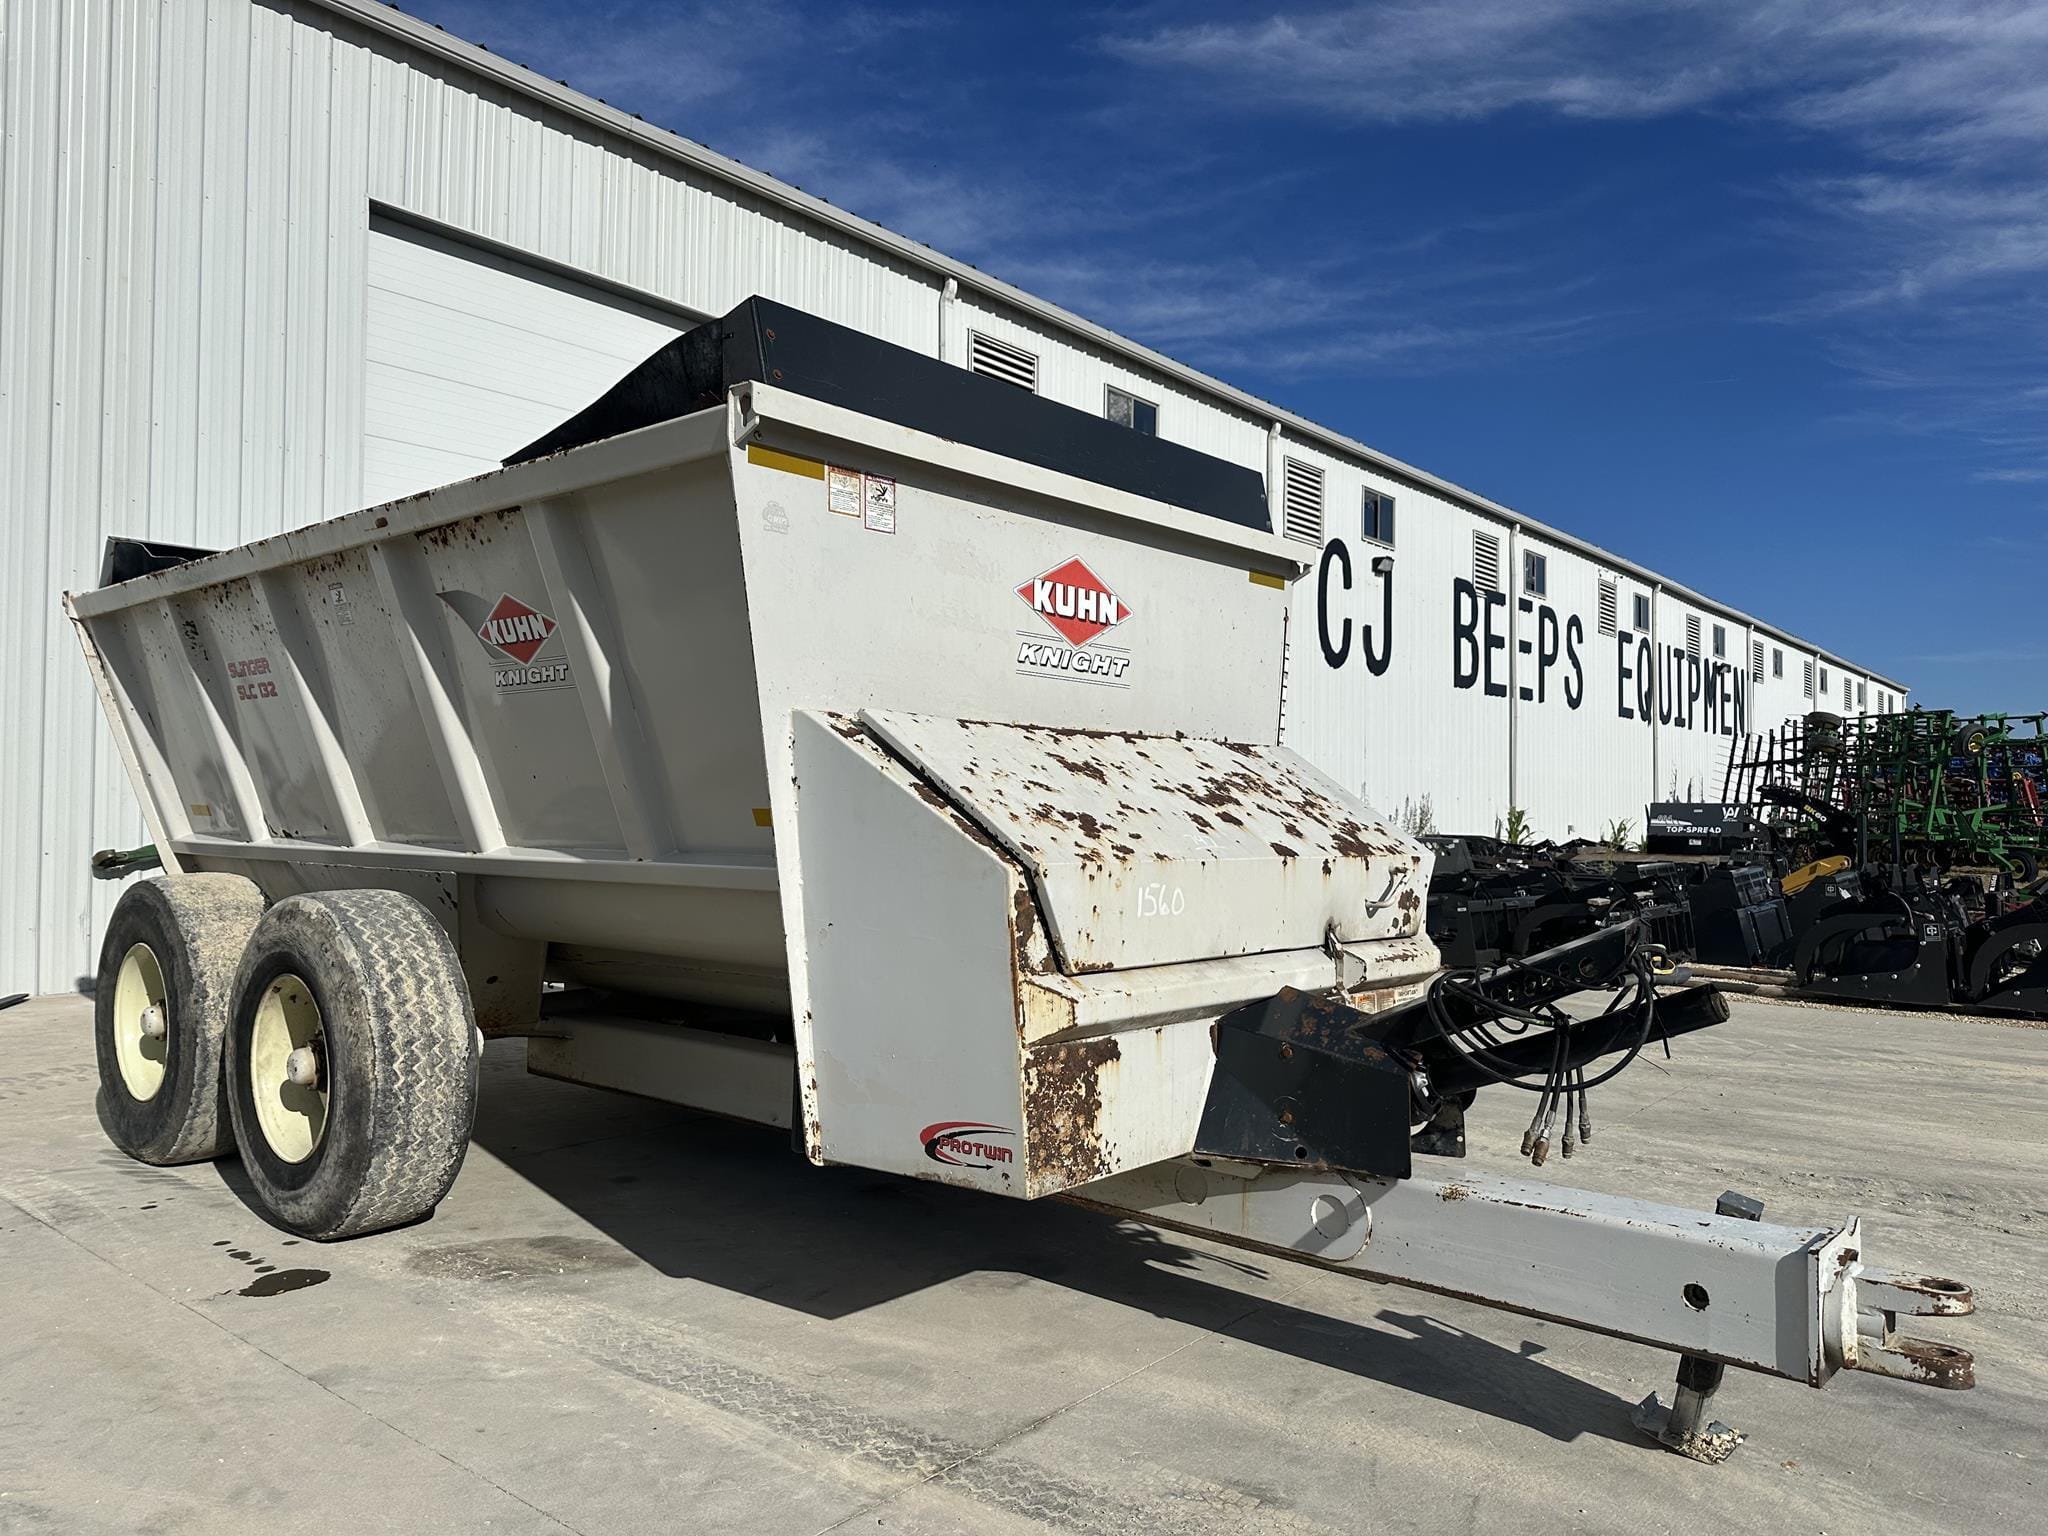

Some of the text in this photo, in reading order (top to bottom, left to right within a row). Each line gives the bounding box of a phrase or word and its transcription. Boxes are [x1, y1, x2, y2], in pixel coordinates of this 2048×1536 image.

[1033, 577, 1118, 626] KUHN
[486, 613, 548, 646] KUHN
[1317, 537, 1393, 676] CJ
[1453, 576, 1583, 709] BEEPS
[227, 657, 271, 679] SLINGER
[1017, 642, 1130, 677] KNIGHT
[236, 681, 278, 700] SLC 132
[495, 664, 568, 687] KNIGHT
[1666, 826, 1722, 834] TOP-SPREAD
[1137, 882, 1185, 918] 1560
[939, 1137, 1013, 1164] PROTWIN
